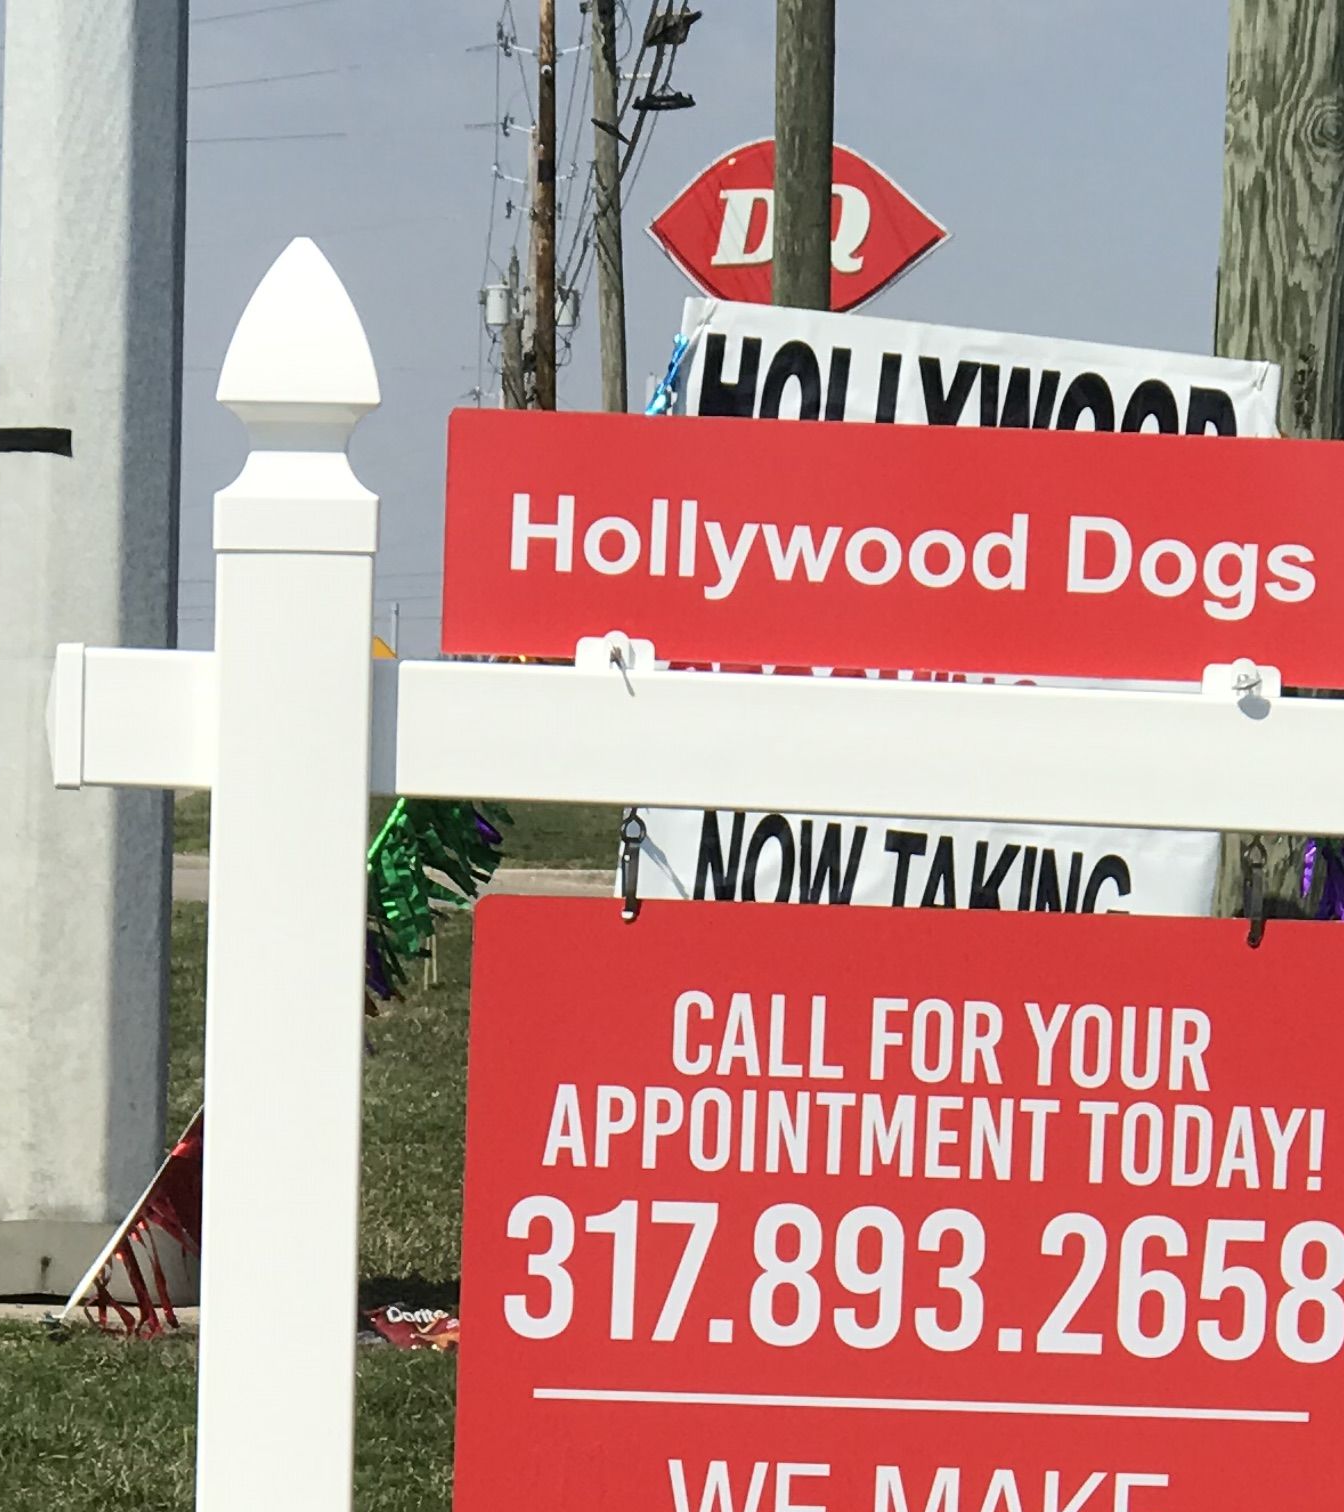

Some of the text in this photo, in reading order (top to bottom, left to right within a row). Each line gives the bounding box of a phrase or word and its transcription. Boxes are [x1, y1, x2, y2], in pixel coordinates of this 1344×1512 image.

[510, 493, 1317, 622] Hollywood Dogs
[692, 810, 1132, 915] NOW TAKING
[672, 990, 1211, 1092] CALL FOR YOUR
[542, 1083, 1326, 1191] APPOINTMENT TODAY!
